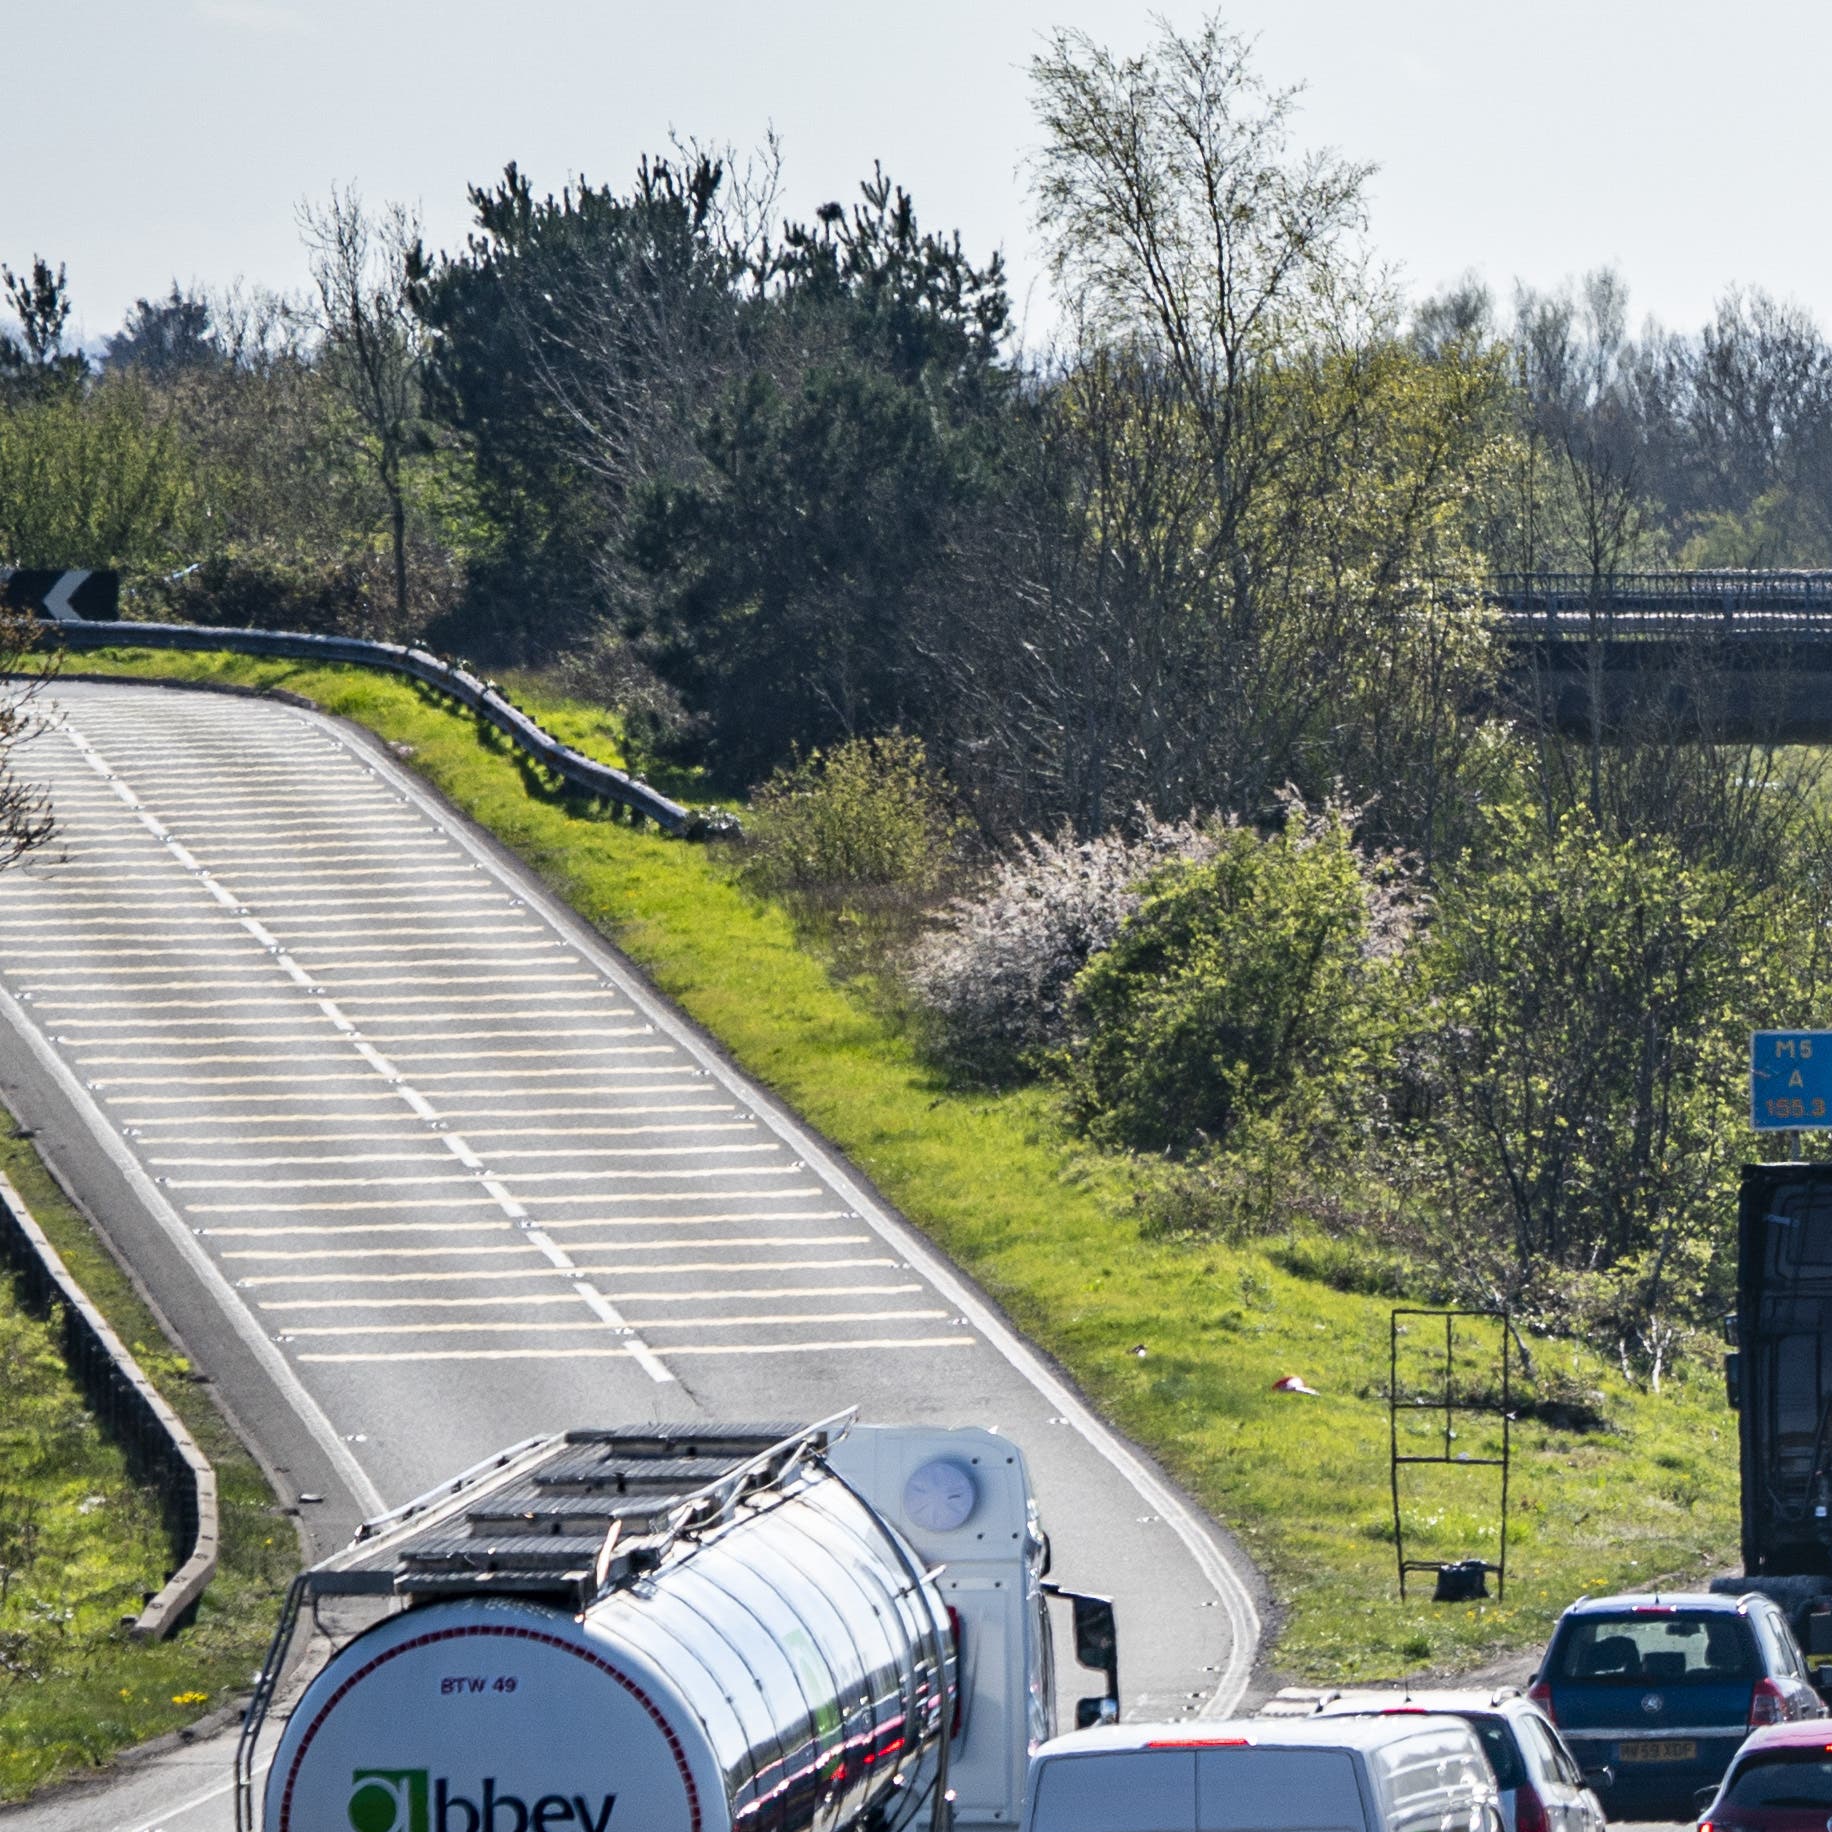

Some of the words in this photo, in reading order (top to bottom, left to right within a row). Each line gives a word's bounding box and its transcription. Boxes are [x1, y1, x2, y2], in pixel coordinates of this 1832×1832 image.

[1788, 1070, 1803, 1088] A
[440, 1678, 486, 1695] BTW
[492, 1676, 518, 1693] 49
